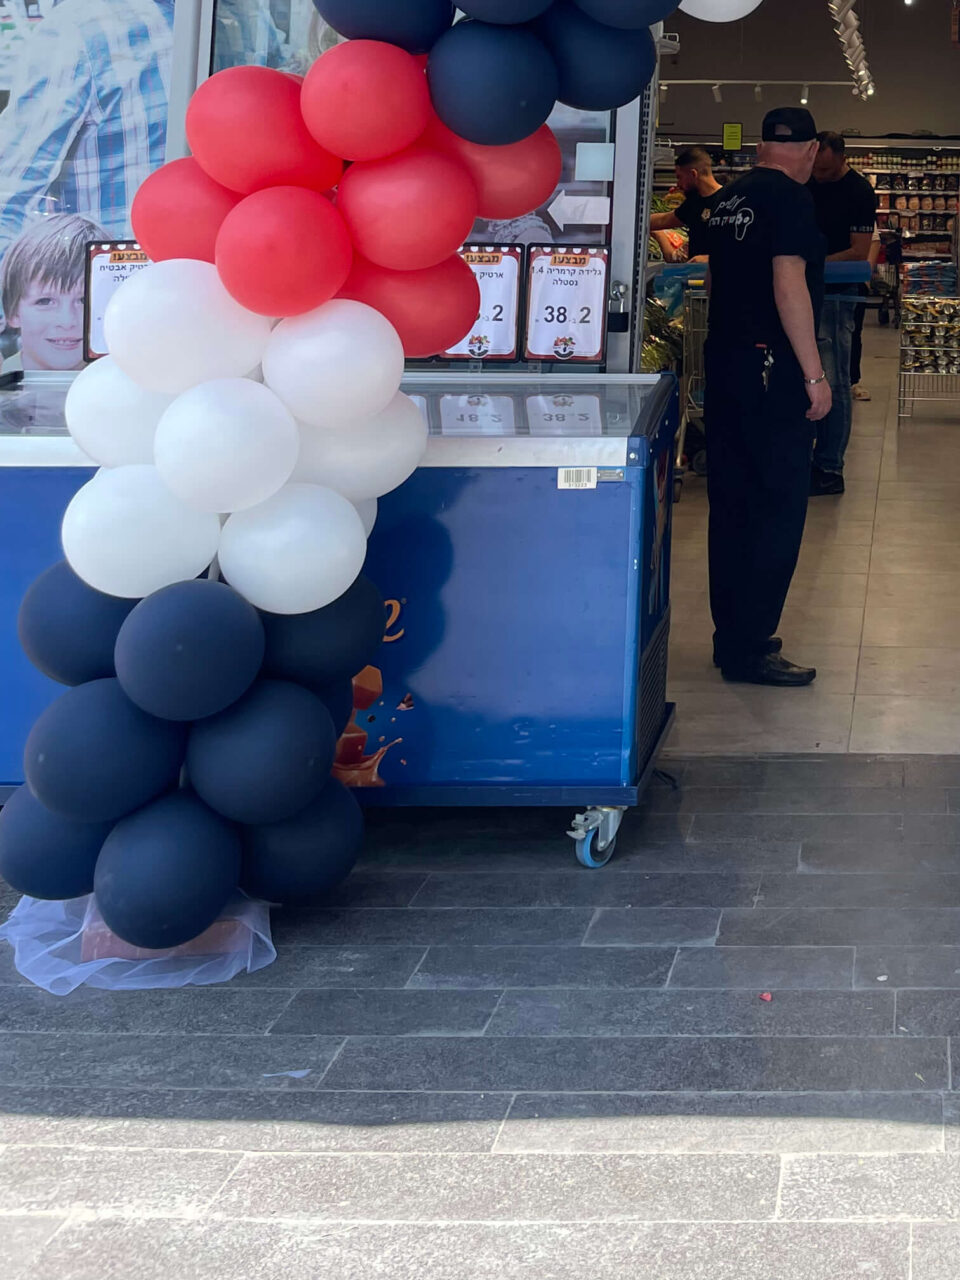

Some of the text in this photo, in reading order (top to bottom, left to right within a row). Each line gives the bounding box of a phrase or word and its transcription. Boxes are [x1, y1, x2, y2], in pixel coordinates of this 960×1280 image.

[99, 264, 127, 272] אבטיח
[547, 267, 576, 277] קרמריה
[579, 267, 602, 276] גלידה
[479, 271, 504, 280] ארטיק
[552, 278, 578, 286] נסטלה
[492, 304, 504, 322] 2
[543, 305, 567, 324] 38
[579, 306, 591, 324] 2
